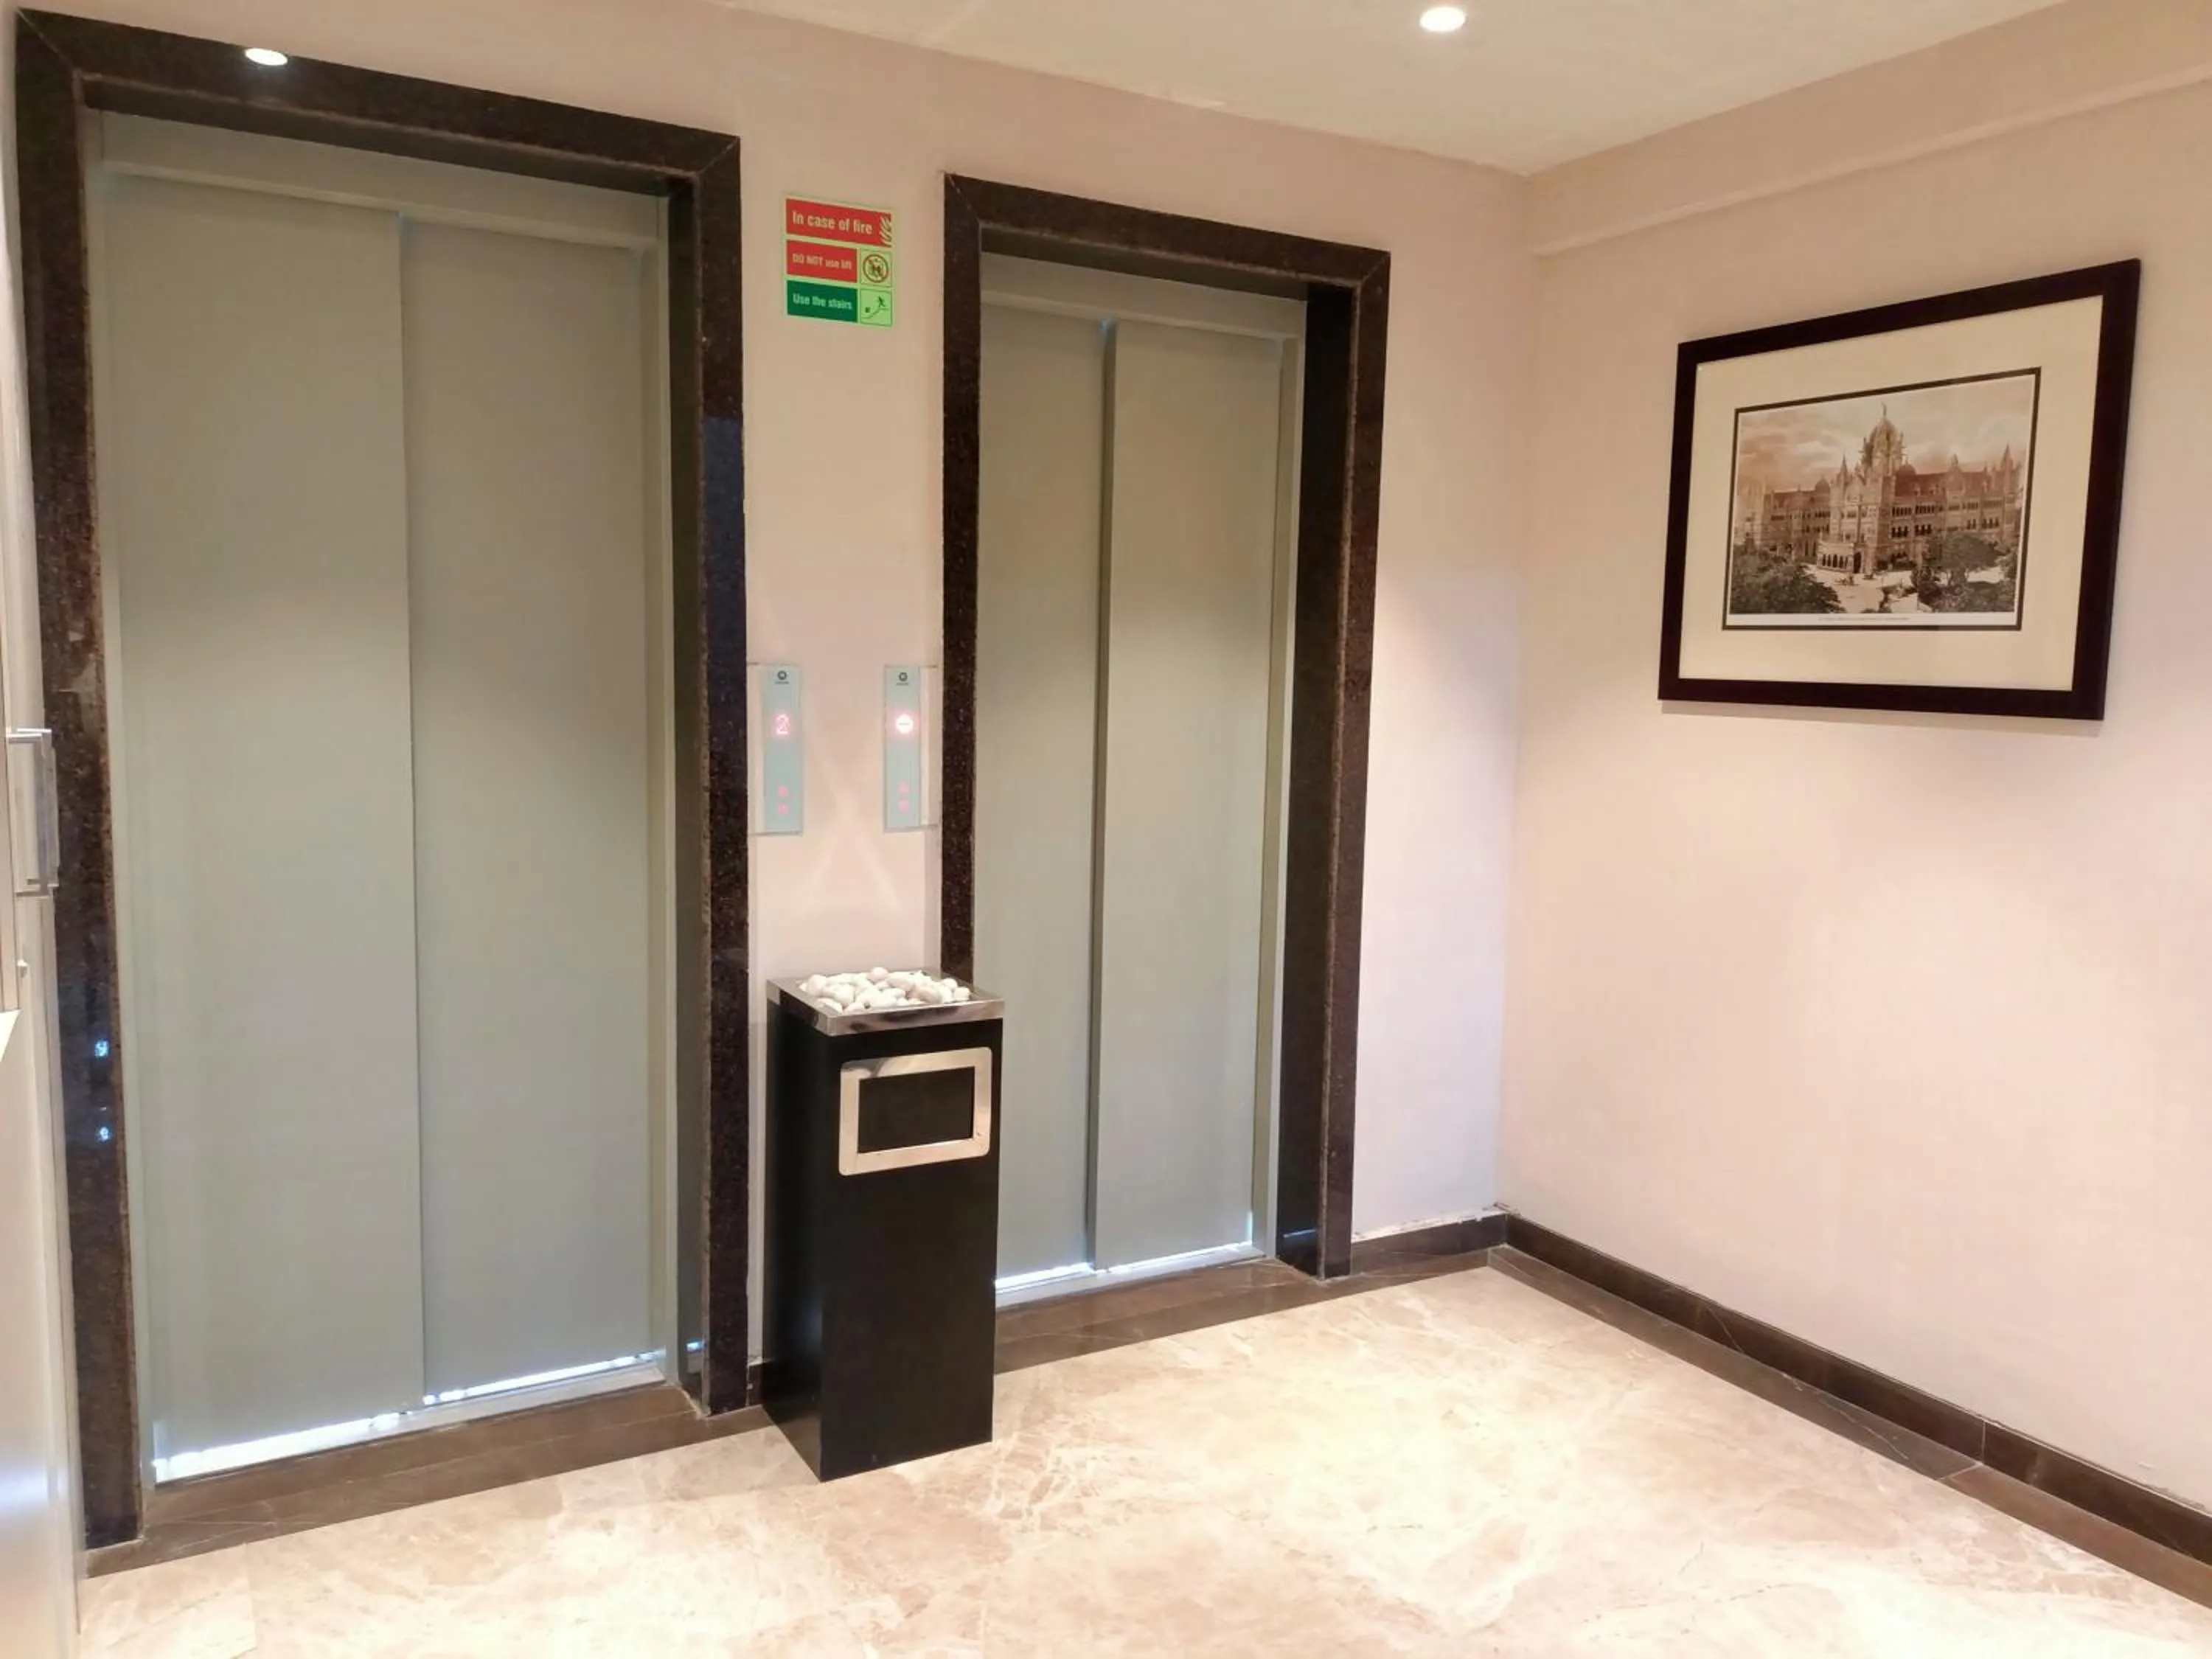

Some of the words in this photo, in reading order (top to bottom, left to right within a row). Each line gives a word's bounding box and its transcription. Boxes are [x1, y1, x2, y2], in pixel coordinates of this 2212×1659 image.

[792, 211, 804, 225] In
[807, 215, 835, 230] case
[838, 219, 850, 232] of
[853, 220, 873, 234] fire
[793, 253, 804, 263] DO
[806, 254, 823, 265] NOT
[825, 259, 839, 268] use
[793, 293, 810, 305] Use
[812, 296, 826, 307] the
[828, 299, 852, 310] stairs
[776, 714, 789, 734] 2
